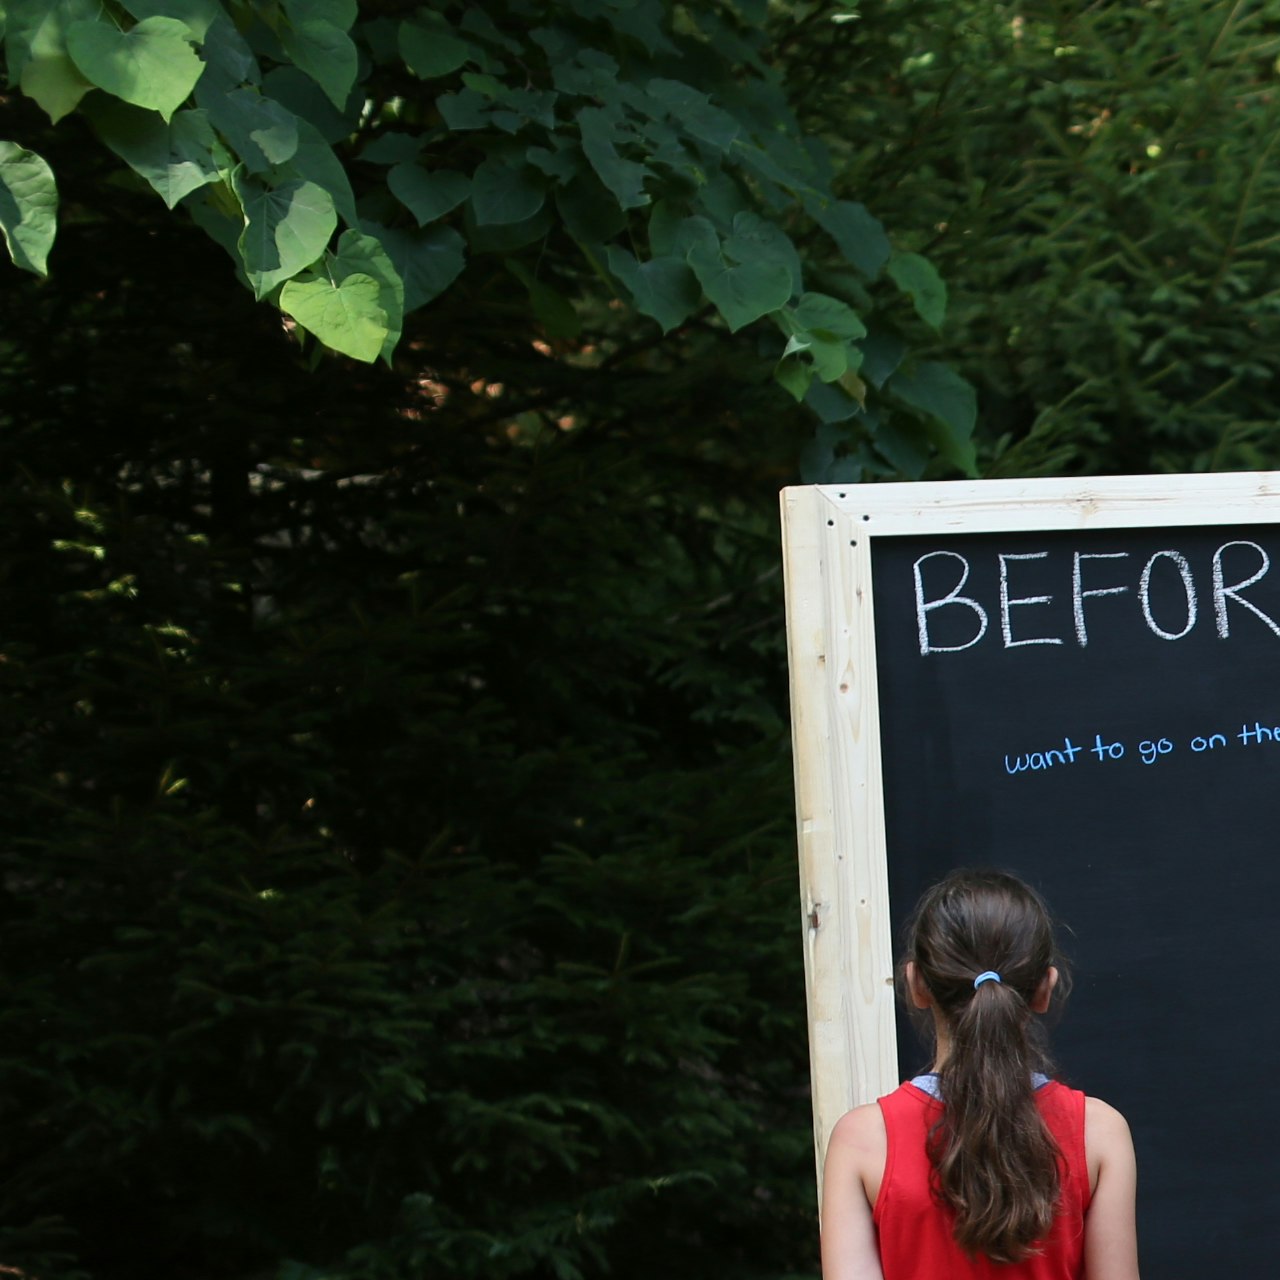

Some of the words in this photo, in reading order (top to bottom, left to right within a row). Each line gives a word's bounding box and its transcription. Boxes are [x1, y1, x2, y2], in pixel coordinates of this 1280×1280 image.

[1004, 737, 1083, 775] want
[1090, 734, 1125, 762] to
[1138, 737, 1174, 765] go
[1190, 733, 1227, 752] on
